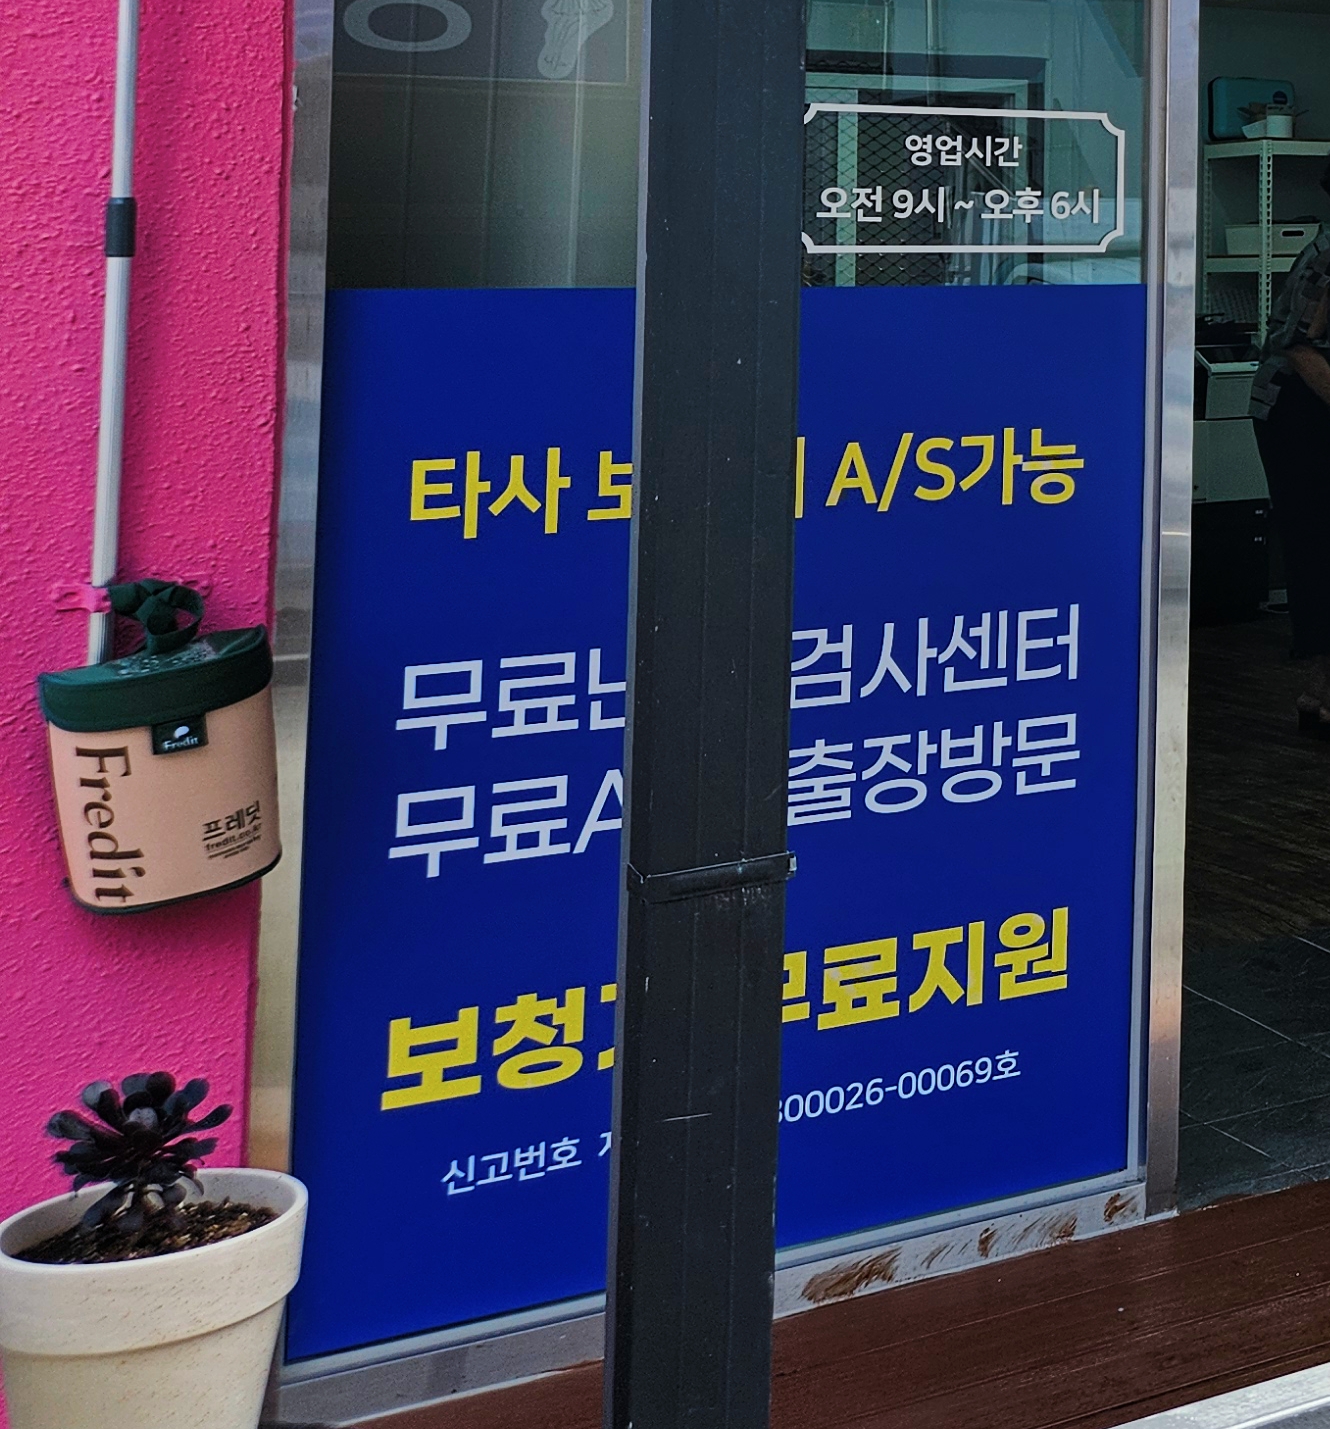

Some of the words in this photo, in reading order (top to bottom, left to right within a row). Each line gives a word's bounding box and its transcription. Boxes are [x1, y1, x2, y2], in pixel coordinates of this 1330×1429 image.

[904, 133, 1024, 168] 영업시간
[816, 186, 884, 223] 오전
[893, 186, 946, 227] 9시
[980, 187, 1044, 226] 오후
[1051, 188, 1101, 226] 6시
[408, 445, 571, 540] 타사
[825, 427, 1086, 515] A/S가능
[789, 603, 1081, 709] 검사센터
[202, 799, 262, 841] 프레딧
[786, 711, 1082, 827] 출장방문
[75, 745, 147, 903] Fredit
[440, 1134, 584, 1196] 신고번호
[778, 1046, 1022, 1124] 00026-00069호
